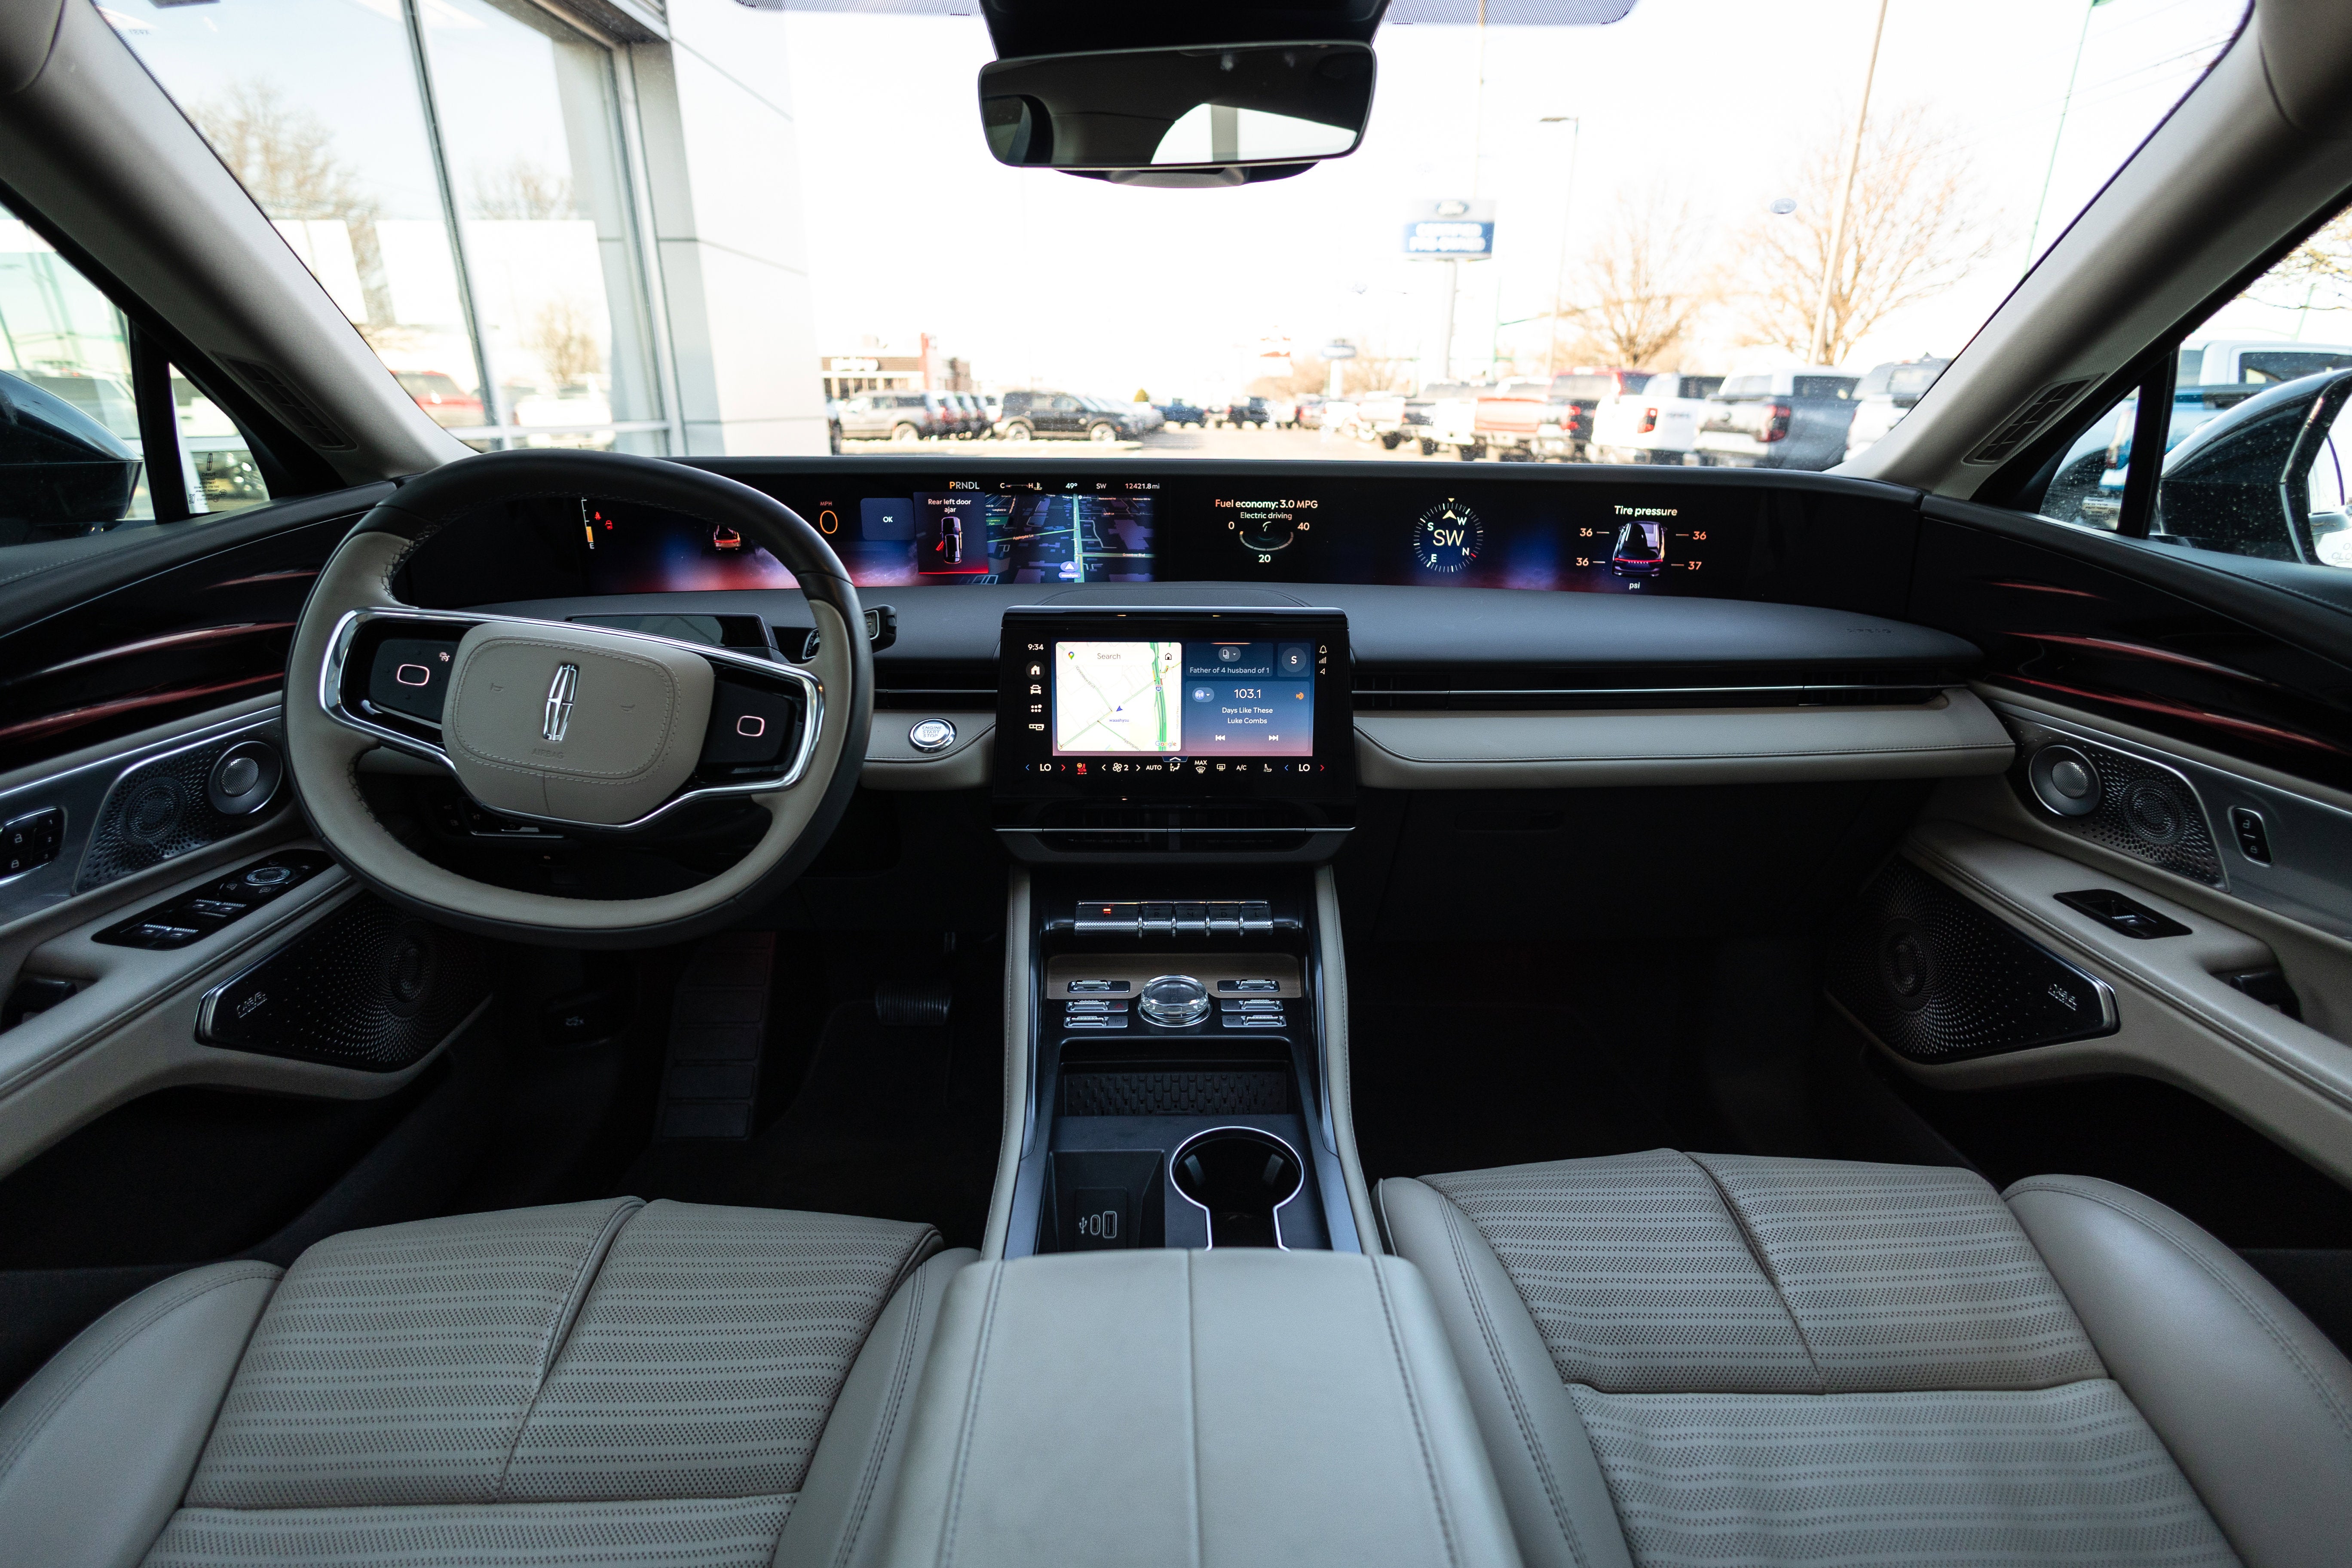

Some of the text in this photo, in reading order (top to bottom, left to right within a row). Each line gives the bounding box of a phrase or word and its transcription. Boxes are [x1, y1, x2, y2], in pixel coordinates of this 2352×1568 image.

[1215, 499, 1318, 510] Fuel economy: 3.0 MPG
[1614, 505, 1678, 517] Tire pressure
[1268, 512, 1292, 520] driving
[820, 510, 838, 534] 0
[1228, 521, 1234, 530] 0
[1297, 522, 1310, 530] 40
[1457, 517, 1467, 526] W
[1427, 522, 1434, 531] S
[1580, 528, 1593, 537] 36
[1693, 531, 1706, 540] 36
[1433, 529, 1464, 546] SW
[1462, 547, 1469, 556] N
[1259, 554, 1271, 563] 20
[1431, 554, 1437, 562] E
[1576, 557, 1589, 567] 36
[1688, 561, 1702, 570] 37
[1291, 655, 1297, 664] S
[1234, 689, 1262, 698] 103.1
[532, 748, 564, 759] AIRBAG
